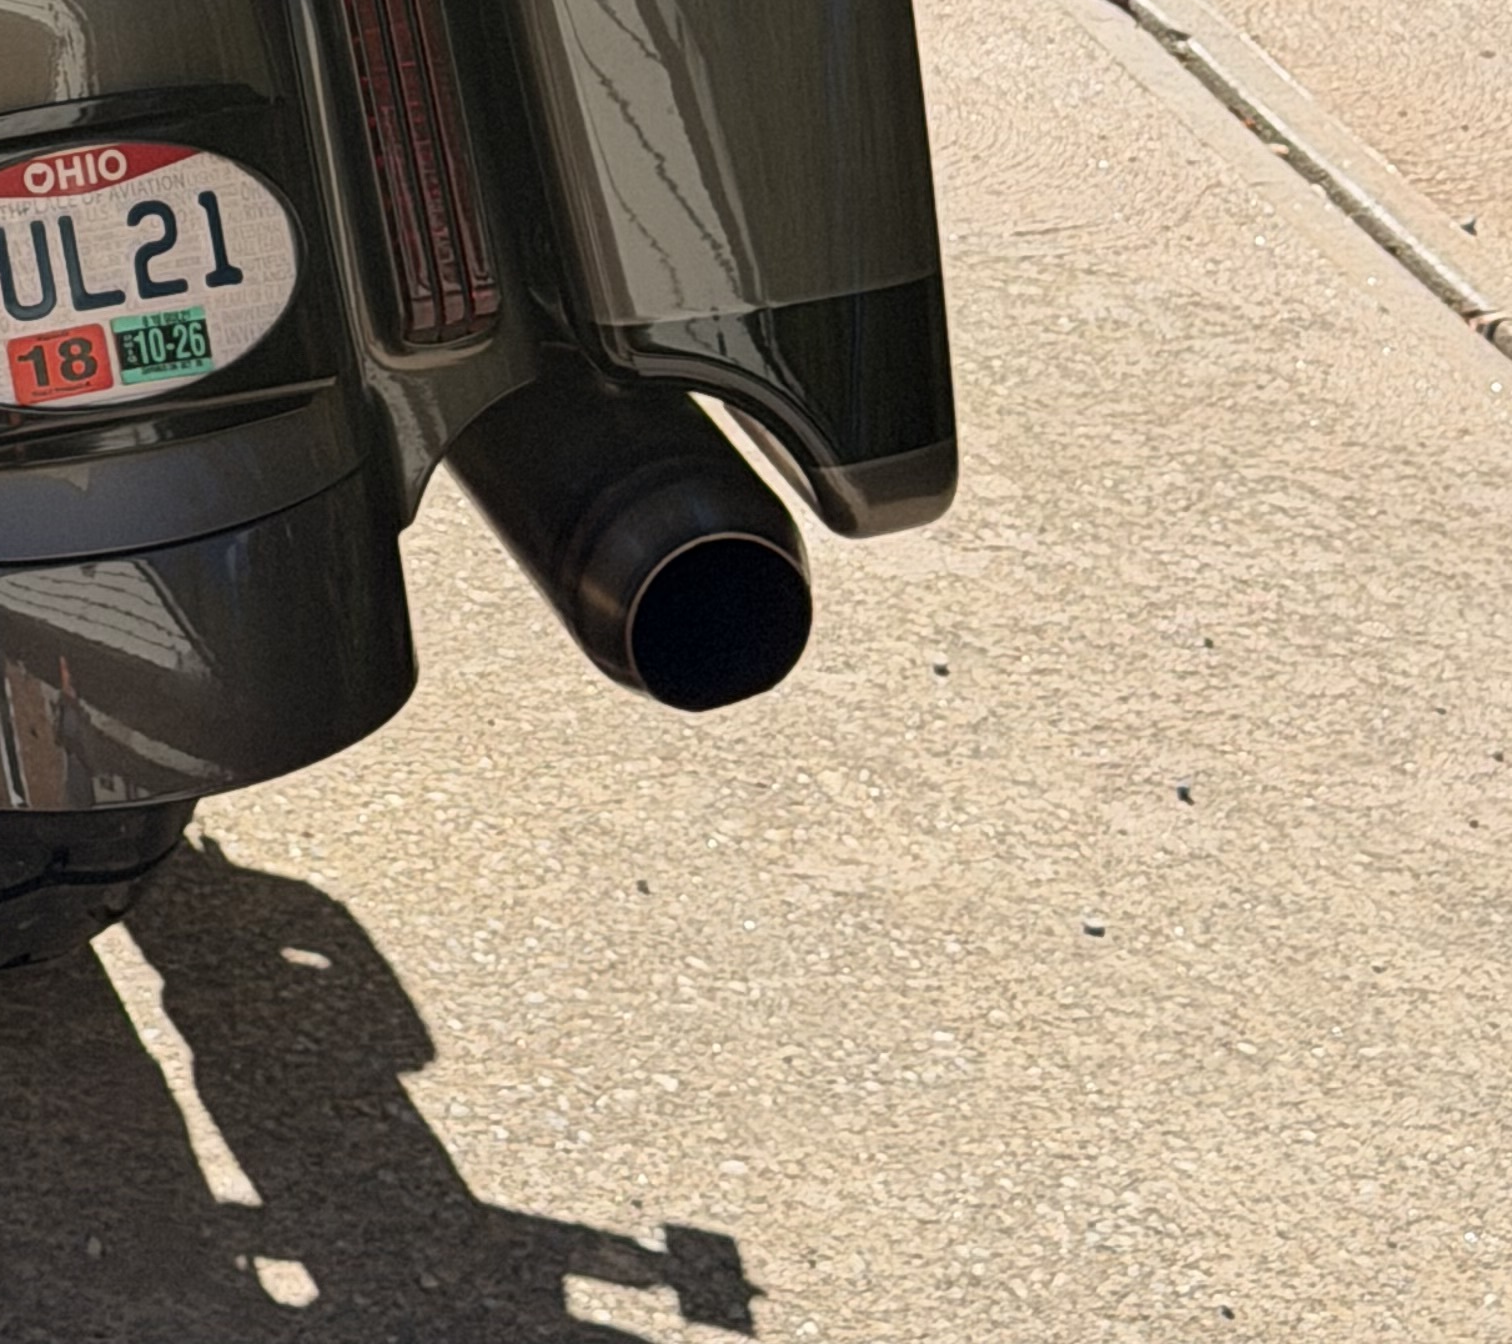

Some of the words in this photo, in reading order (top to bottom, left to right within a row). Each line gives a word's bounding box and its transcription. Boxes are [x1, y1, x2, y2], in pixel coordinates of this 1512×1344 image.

[23, 148, 128, 194] OHIO
[108, 173, 186, 204] AVIATION
[17, 336, 98, 388] 18
[133, 321, 207, 365] 10-26
